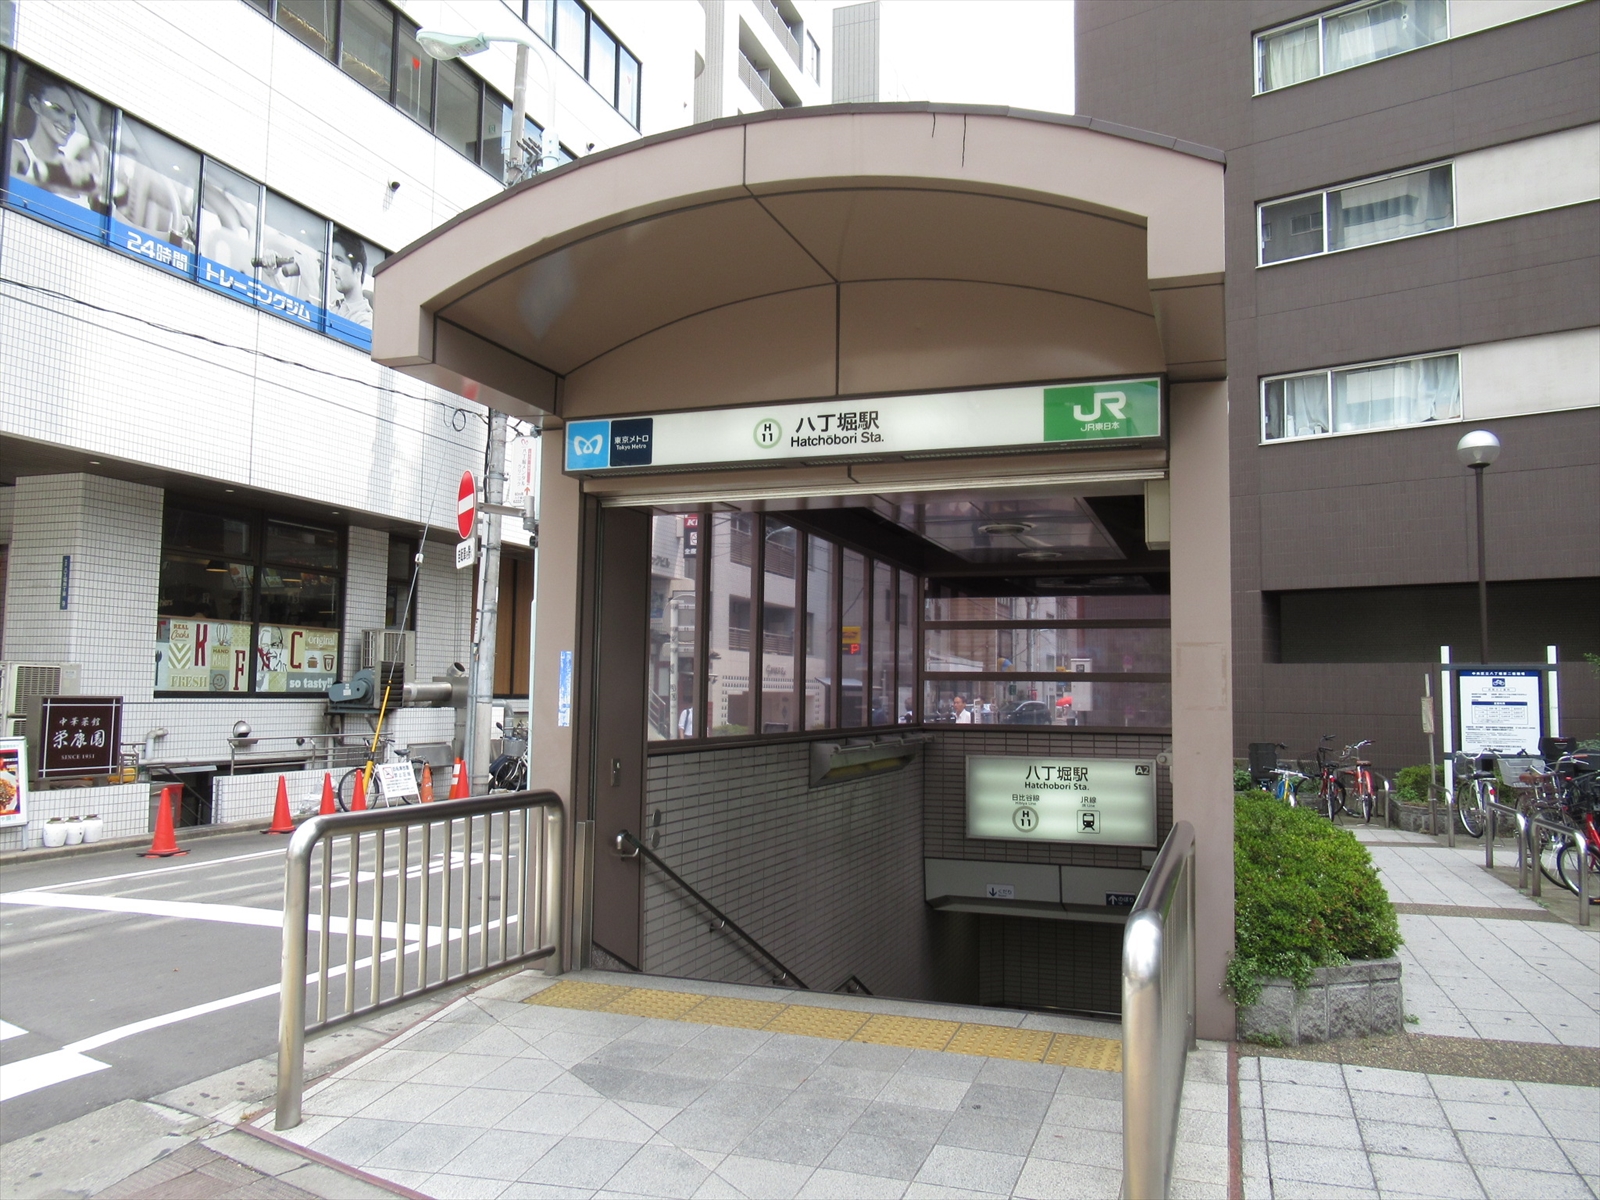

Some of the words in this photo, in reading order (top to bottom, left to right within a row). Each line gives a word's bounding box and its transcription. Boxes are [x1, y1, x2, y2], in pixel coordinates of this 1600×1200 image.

[127, 231, 188, 272] 24時間
[206, 263, 311, 323] トレーニングジム
[1073, 391, 1126, 421] JR
[764, 423, 772, 431] H
[795, 410, 880, 433] 八丁堀駅
[1080, 421, 1120, 432] JR東日本
[614, 434, 649, 444] 東京メトロ
[762, 433, 773, 442] 11
[860, 431, 885, 443] Sta.
[173, 623, 189, 631] REAL
[171, 629, 189, 641] Cooks
[194, 623, 208, 667] K
[308, 635, 336, 648] original
[290, 631, 303, 669] C
[850, 643, 860, 655] P
[233, 649, 246, 691] F
[171, 675, 208, 688] FRESH
[289, 678, 301, 689] so
[1025, 765, 1089, 782] 八丁堀駅
[1136, 766, 1150, 775] A2
[1073, 783, 1090, 791] Sta.
[1012, 794, 1040, 802] 日比谷線
[1080, 796, 1097, 804] JR線
[1021, 818, 1031, 827] 11
